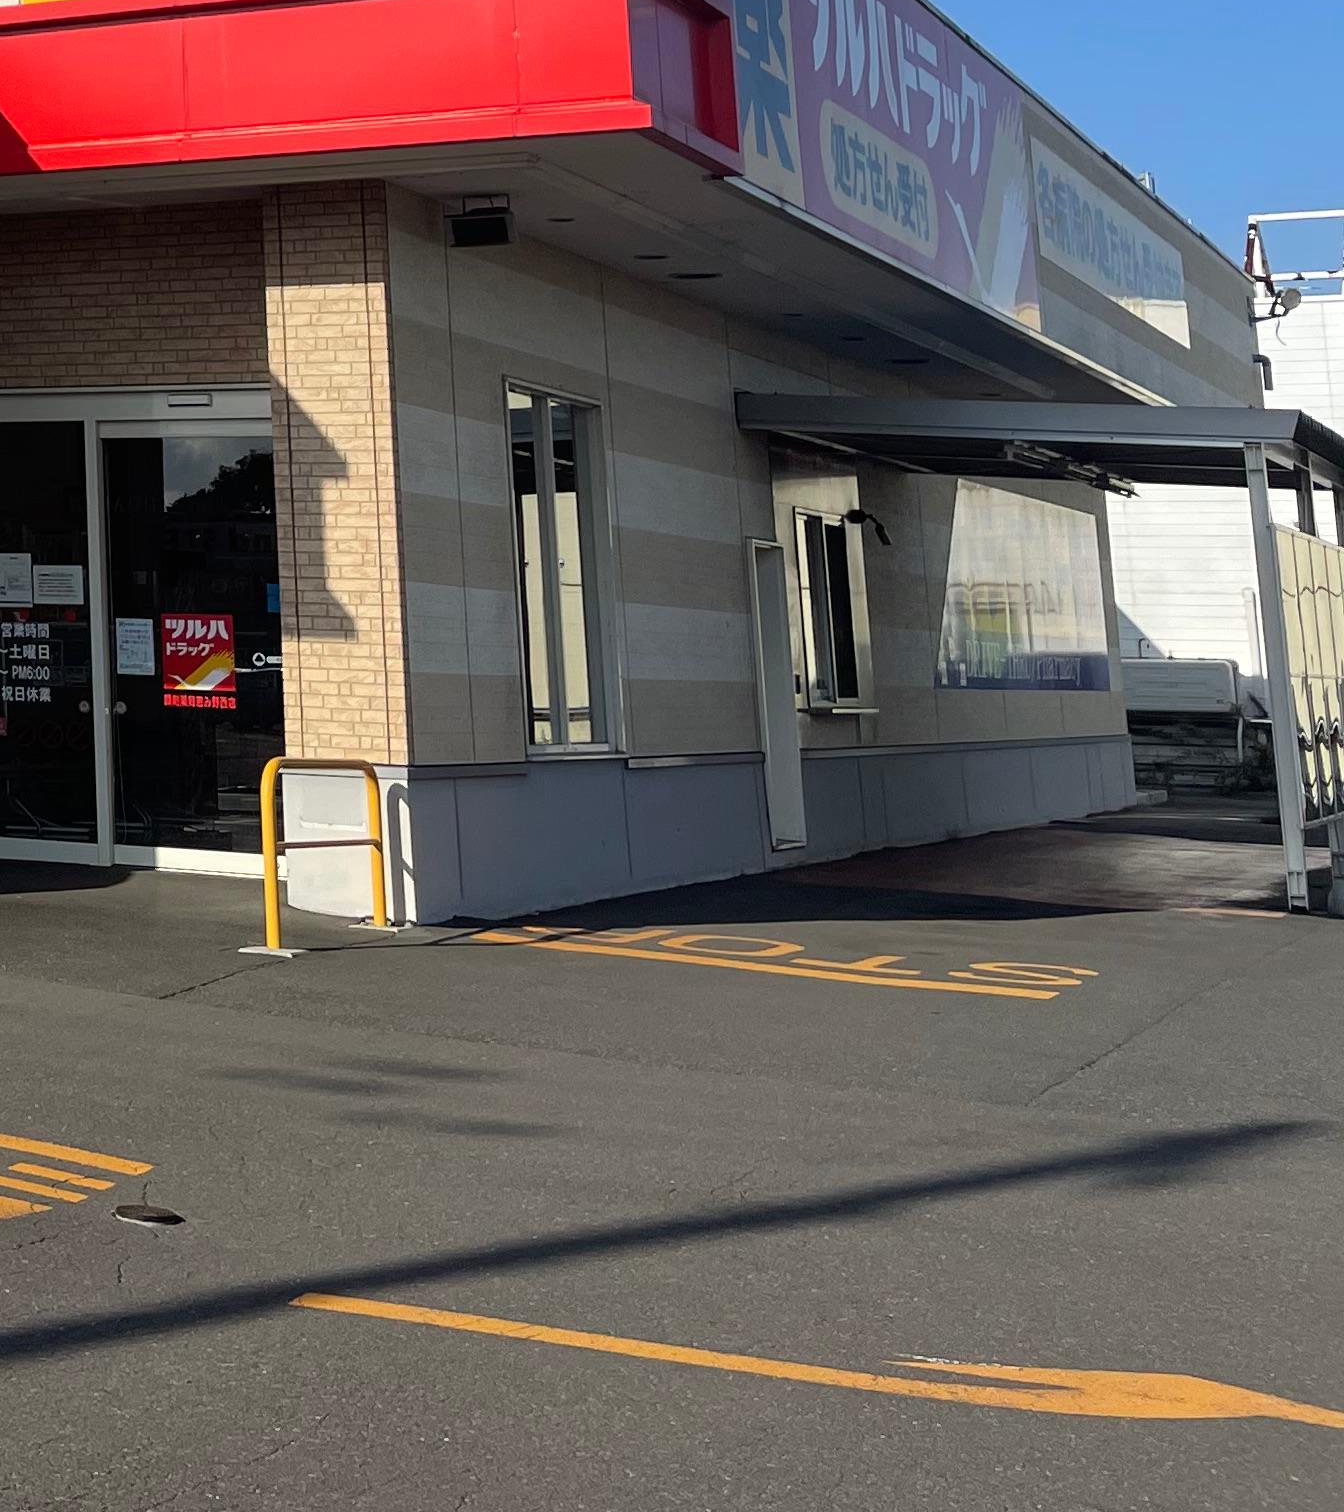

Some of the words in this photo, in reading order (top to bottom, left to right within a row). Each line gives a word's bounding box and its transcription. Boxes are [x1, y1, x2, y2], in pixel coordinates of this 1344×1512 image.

[830, 118, 930, 242] 処方せん受付
[164, 618, 230, 641] ツルハ
[165, 641, 215, 657] ドラッグ
[11, 665, 51, 681] PM6:00
